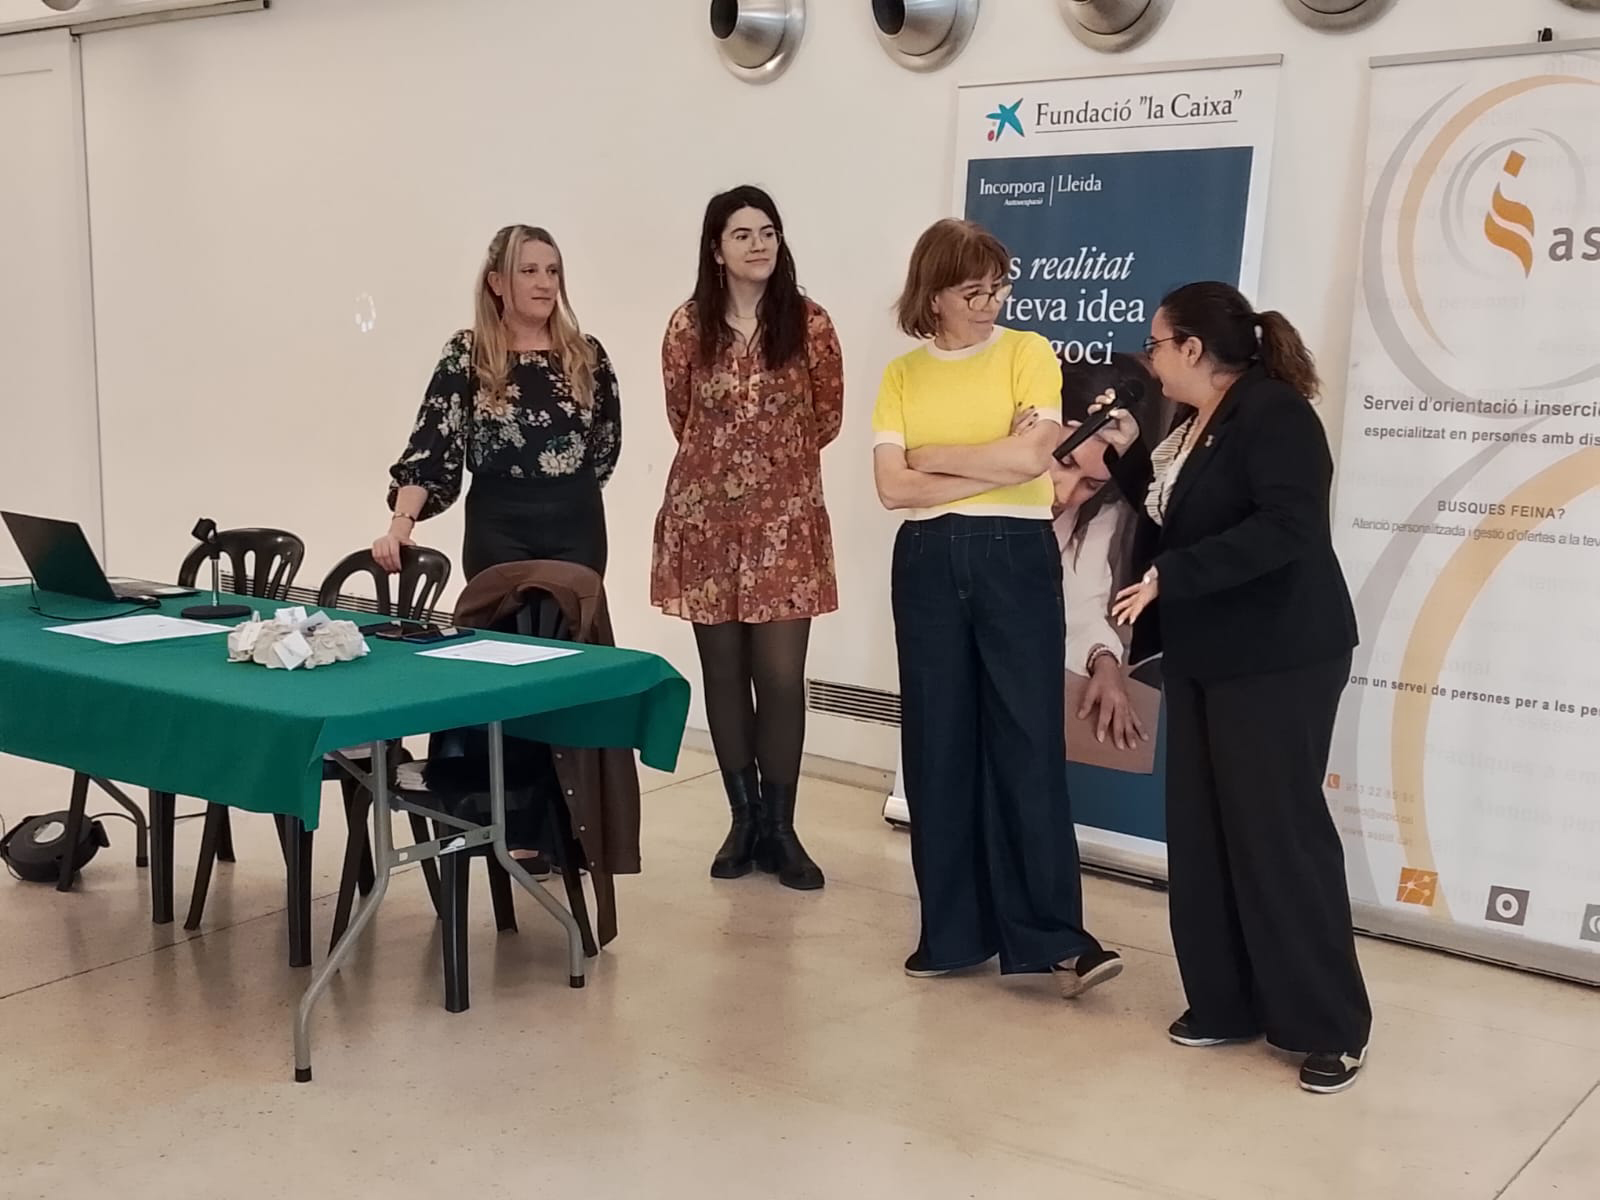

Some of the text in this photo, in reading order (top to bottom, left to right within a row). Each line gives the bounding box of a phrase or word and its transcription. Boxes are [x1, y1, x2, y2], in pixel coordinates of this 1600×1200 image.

[1036, 99, 1132, 126] Fundació
[980, 173, 1102, 197] Incorpora Lleida
[1008, 246, 1135, 281] s realitat
[1005, 289, 1146, 323] teva idea
[1363, 395, 1600, 417] Servei d'orientació i inserci
[1364, 426, 1446, 440] especialitzat
[1449, 430, 1467, 440] en
[1471, 431, 1537, 444] persones
[1542, 432, 1574, 444] amb
[1437, 500, 1566, 520] BUSQUES FEINA?
[1558, 535, 1567, 544] a
[1569, 533, 1580, 545] la
[1350, 675, 1600, 718] om un servei de persones per a les pe
